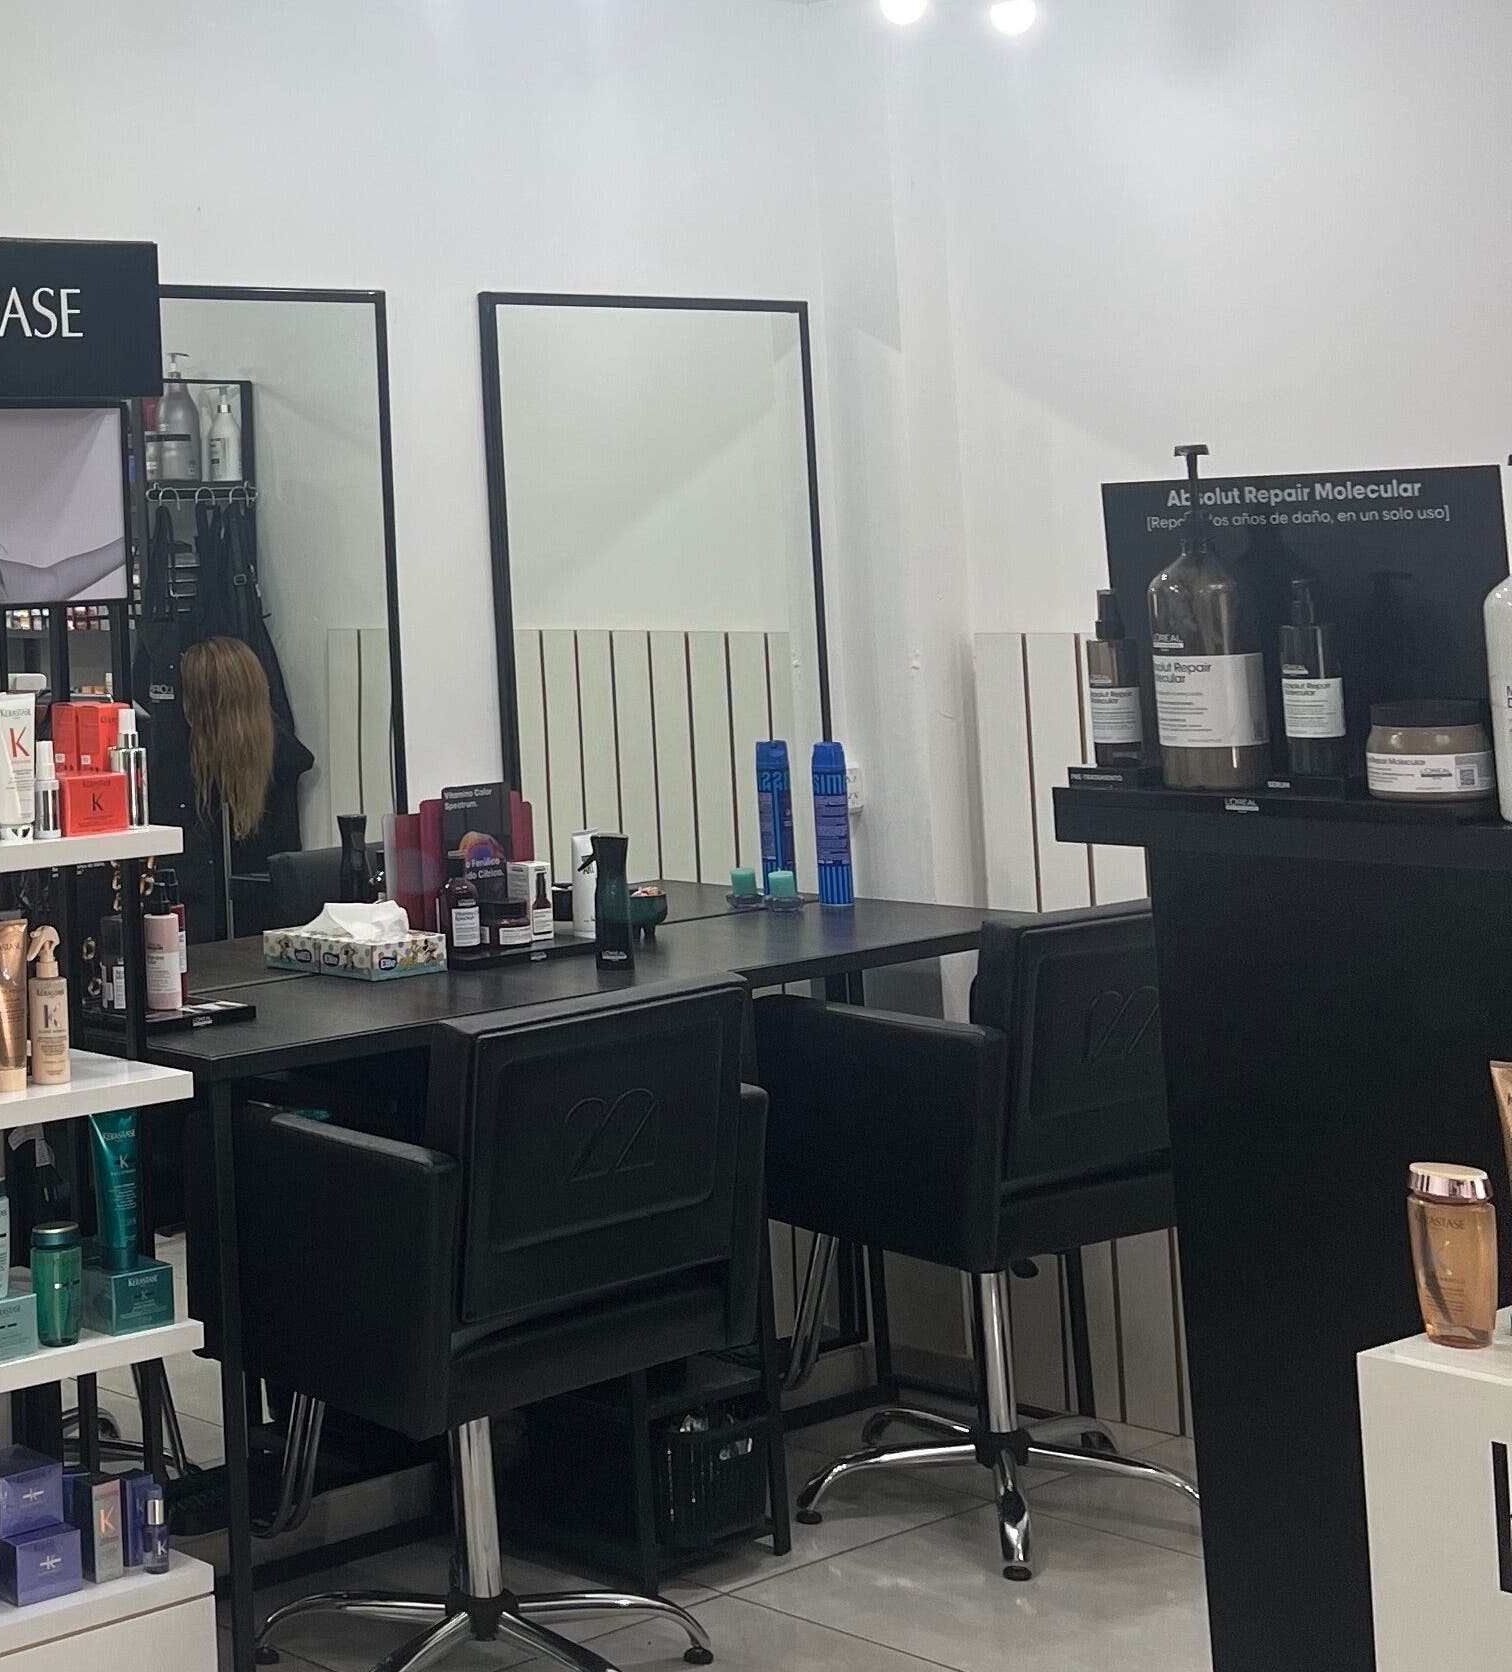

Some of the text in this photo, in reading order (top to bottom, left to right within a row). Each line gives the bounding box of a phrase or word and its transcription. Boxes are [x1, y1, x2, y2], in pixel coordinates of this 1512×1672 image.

[1245, 484, 1311, 506] Repair
[1315, 479, 1422, 500] Molecular
[1232, 512, 1266, 526] años
[1270, 511, 1289, 525] de
[1292, 509, 1332, 525] daño,
[1337, 511, 1357, 522] en
[1360, 510, 1378, 522] un
[1382, 506, 1414, 521] solo
[1418, 504, 1450, 521] uso]
[1174, 662, 1212, 675] Repair
[9, 726, 30, 757] K
[92, 792, 104, 811] K
[444, 788, 492, 800] Vitamino Color
[43, 1003, 60, 1028] K
[99, 1505, 115, 1533] K
[157, 1539, 167, 1555] K
